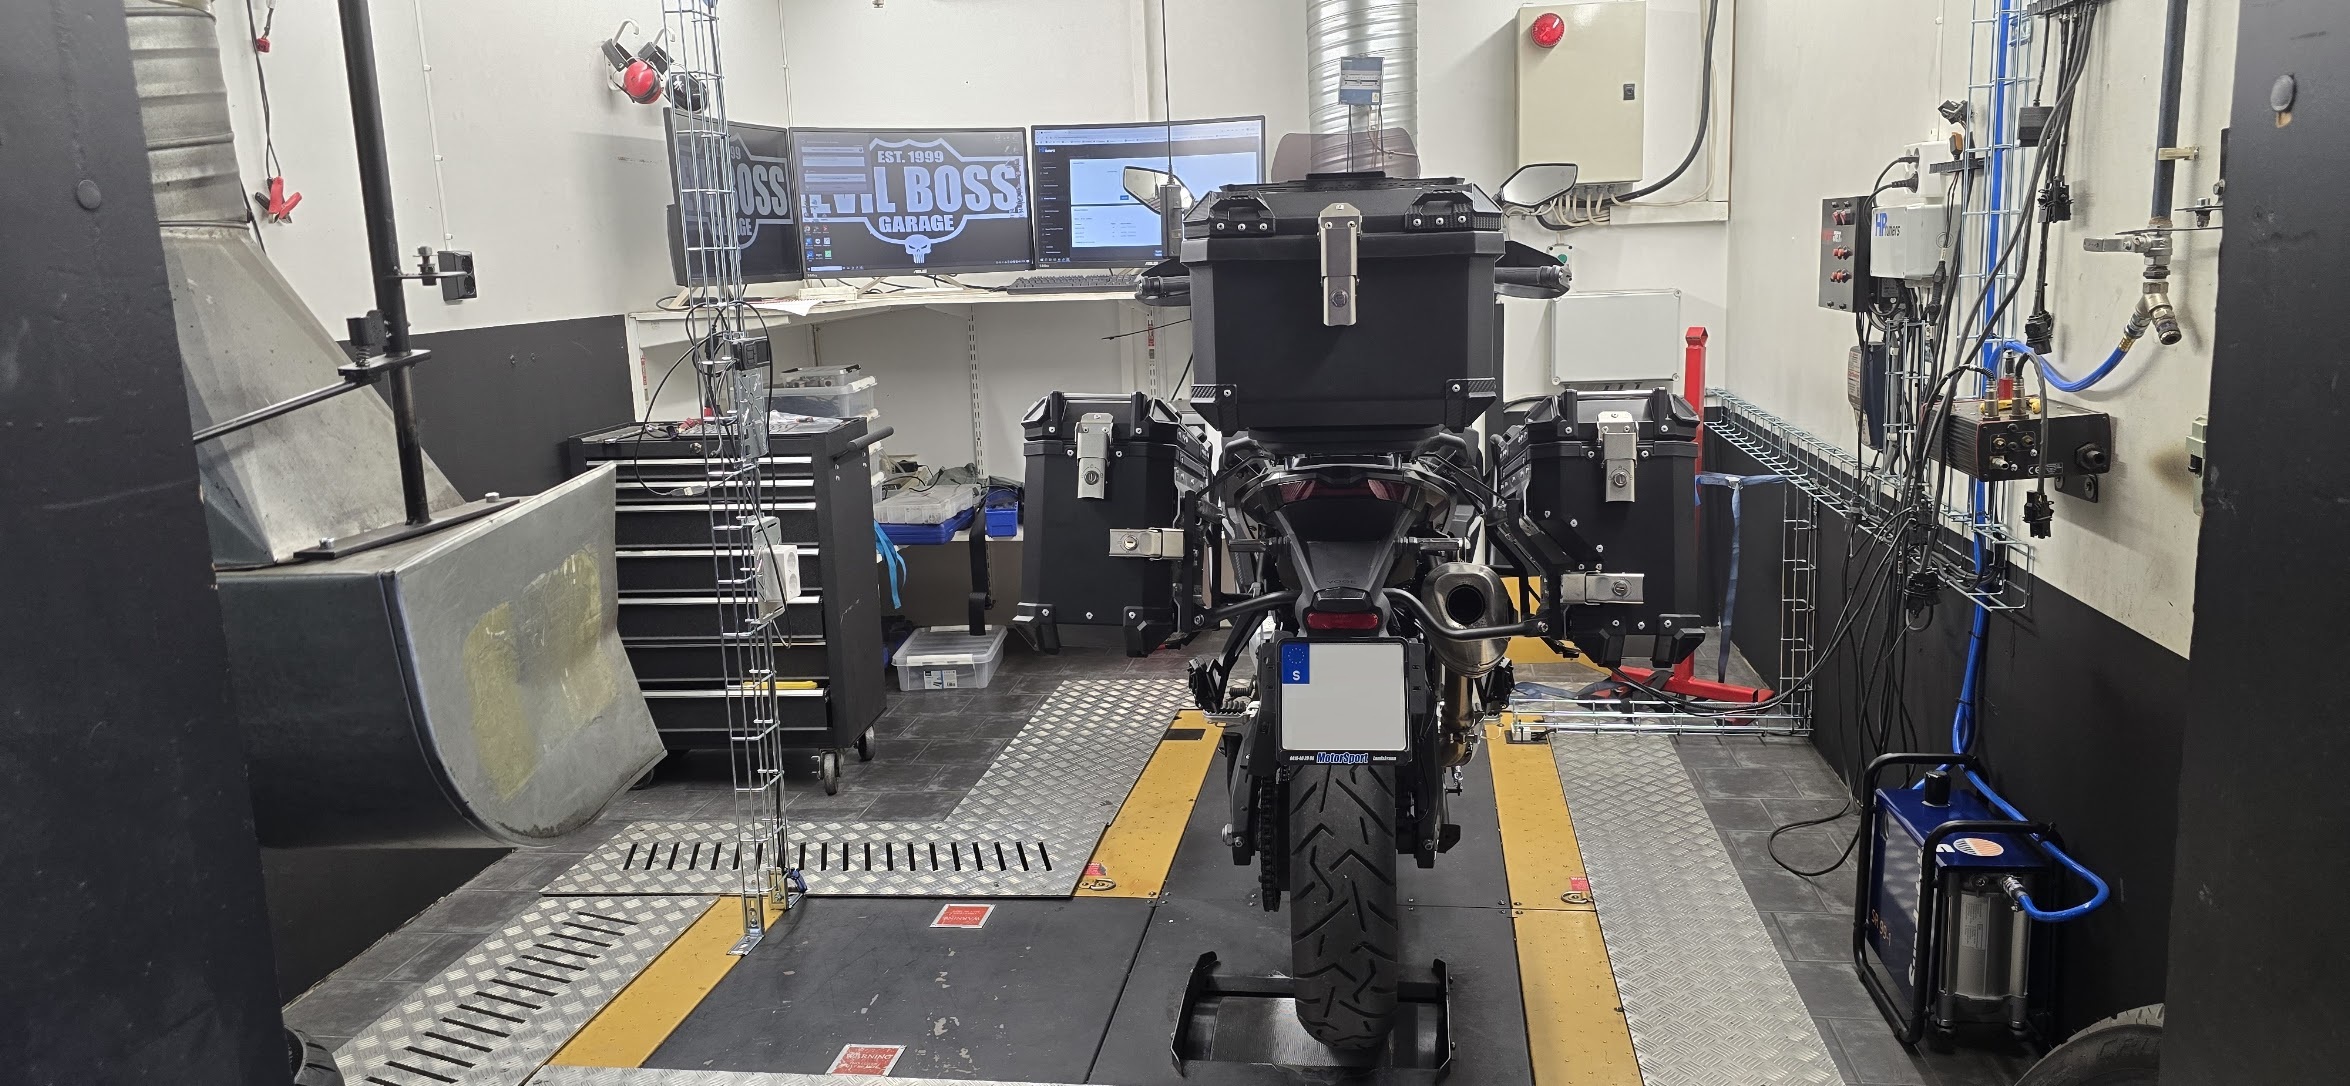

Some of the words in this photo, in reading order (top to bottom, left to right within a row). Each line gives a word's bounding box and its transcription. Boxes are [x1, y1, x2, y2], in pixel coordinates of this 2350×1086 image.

[877, 150, 905, 163] EST.
[908, 150, 944, 163] 1999
[903, 164, 1018, 213] BOSS
[878, 214, 955, 233] GARAGE
[1292, 670, 1301, 681] S
[1316, 752, 1369, 765] MotorSport
